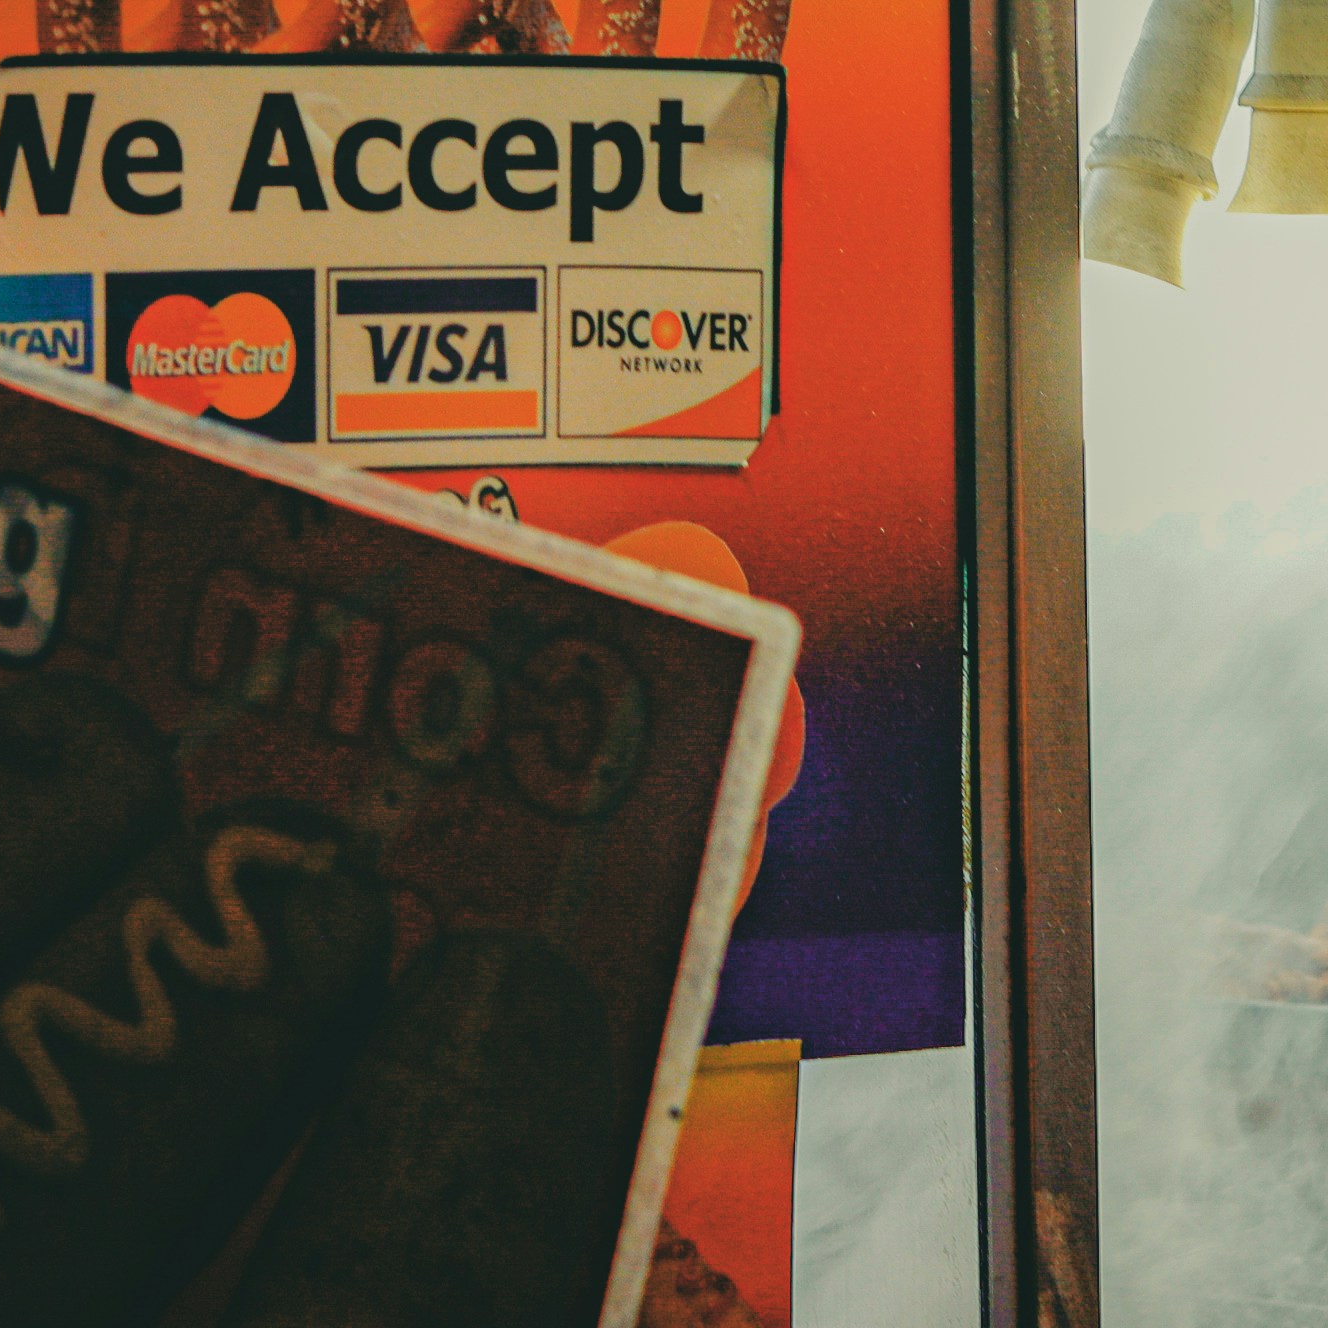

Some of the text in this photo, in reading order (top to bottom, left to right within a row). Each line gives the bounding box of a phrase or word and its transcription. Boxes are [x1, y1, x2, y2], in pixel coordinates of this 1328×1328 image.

[229, 91, 705, 243] Accept
[571, 309, 750, 353] DISCOVER
[131, 340, 292, 377] MasterCard
[362, 325, 511, 384] VISA
[620, 357, 703, 374] NETWORK
